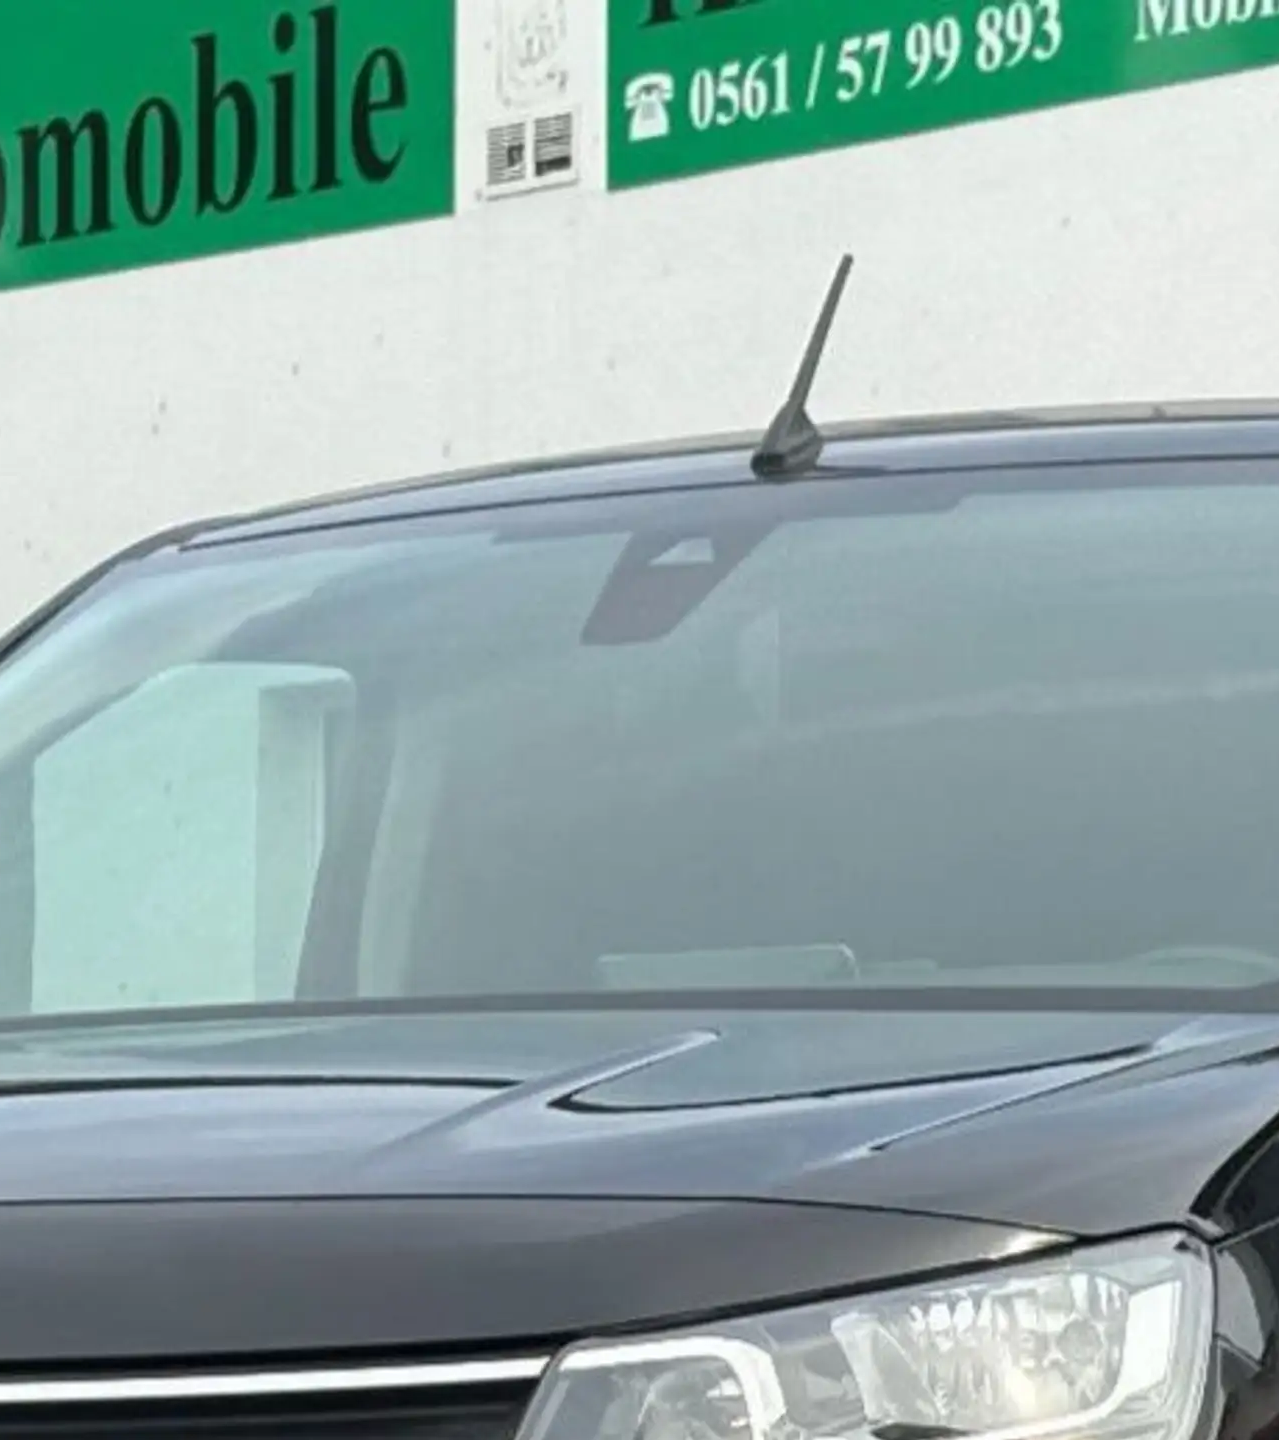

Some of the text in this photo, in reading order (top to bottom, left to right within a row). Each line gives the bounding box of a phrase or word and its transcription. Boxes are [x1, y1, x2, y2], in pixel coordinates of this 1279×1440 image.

[688, 51, 791, 130] 0561
[805, 43, 825, 109] /
[835, 29, 891, 102] 57
[905, 15, 961, 90] 99
[975, 0, 1063, 73] 893
